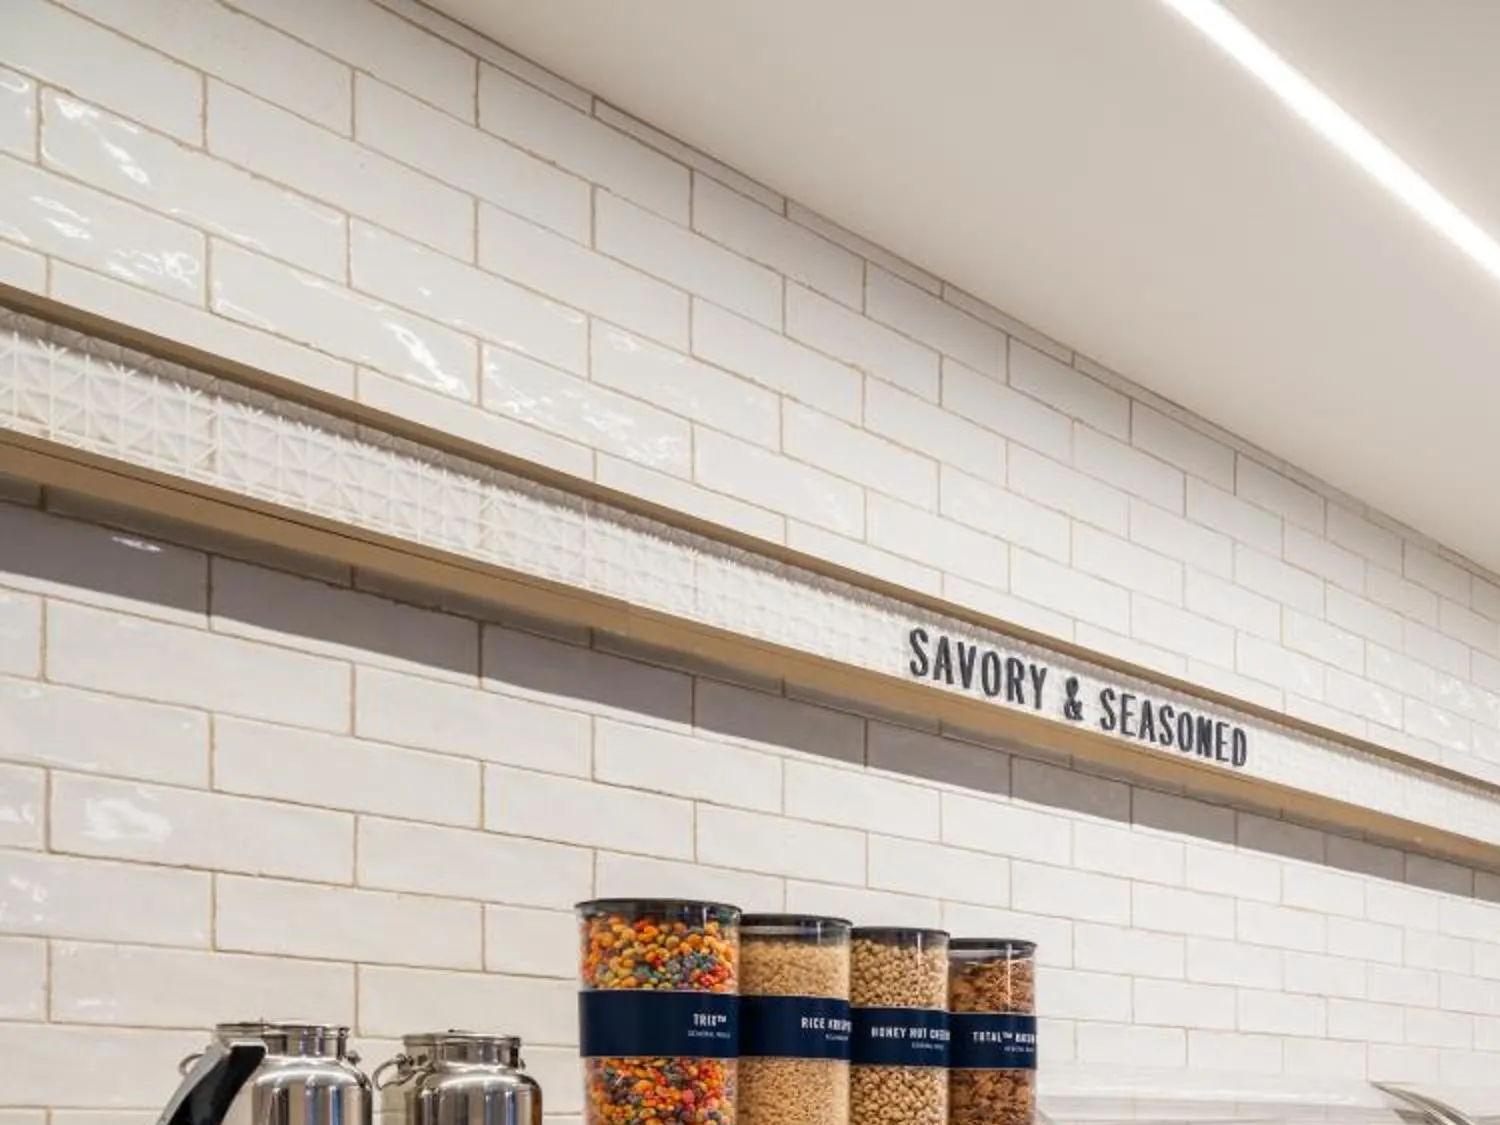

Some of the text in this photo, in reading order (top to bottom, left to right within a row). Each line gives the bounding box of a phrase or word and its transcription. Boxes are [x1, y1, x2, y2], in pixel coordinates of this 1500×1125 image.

[909, 628, 1248, 767] SAVORY & SEASONED
[801, 1016, 825, 1030] RICE
[871, 1026, 906, 1039] HONEY
